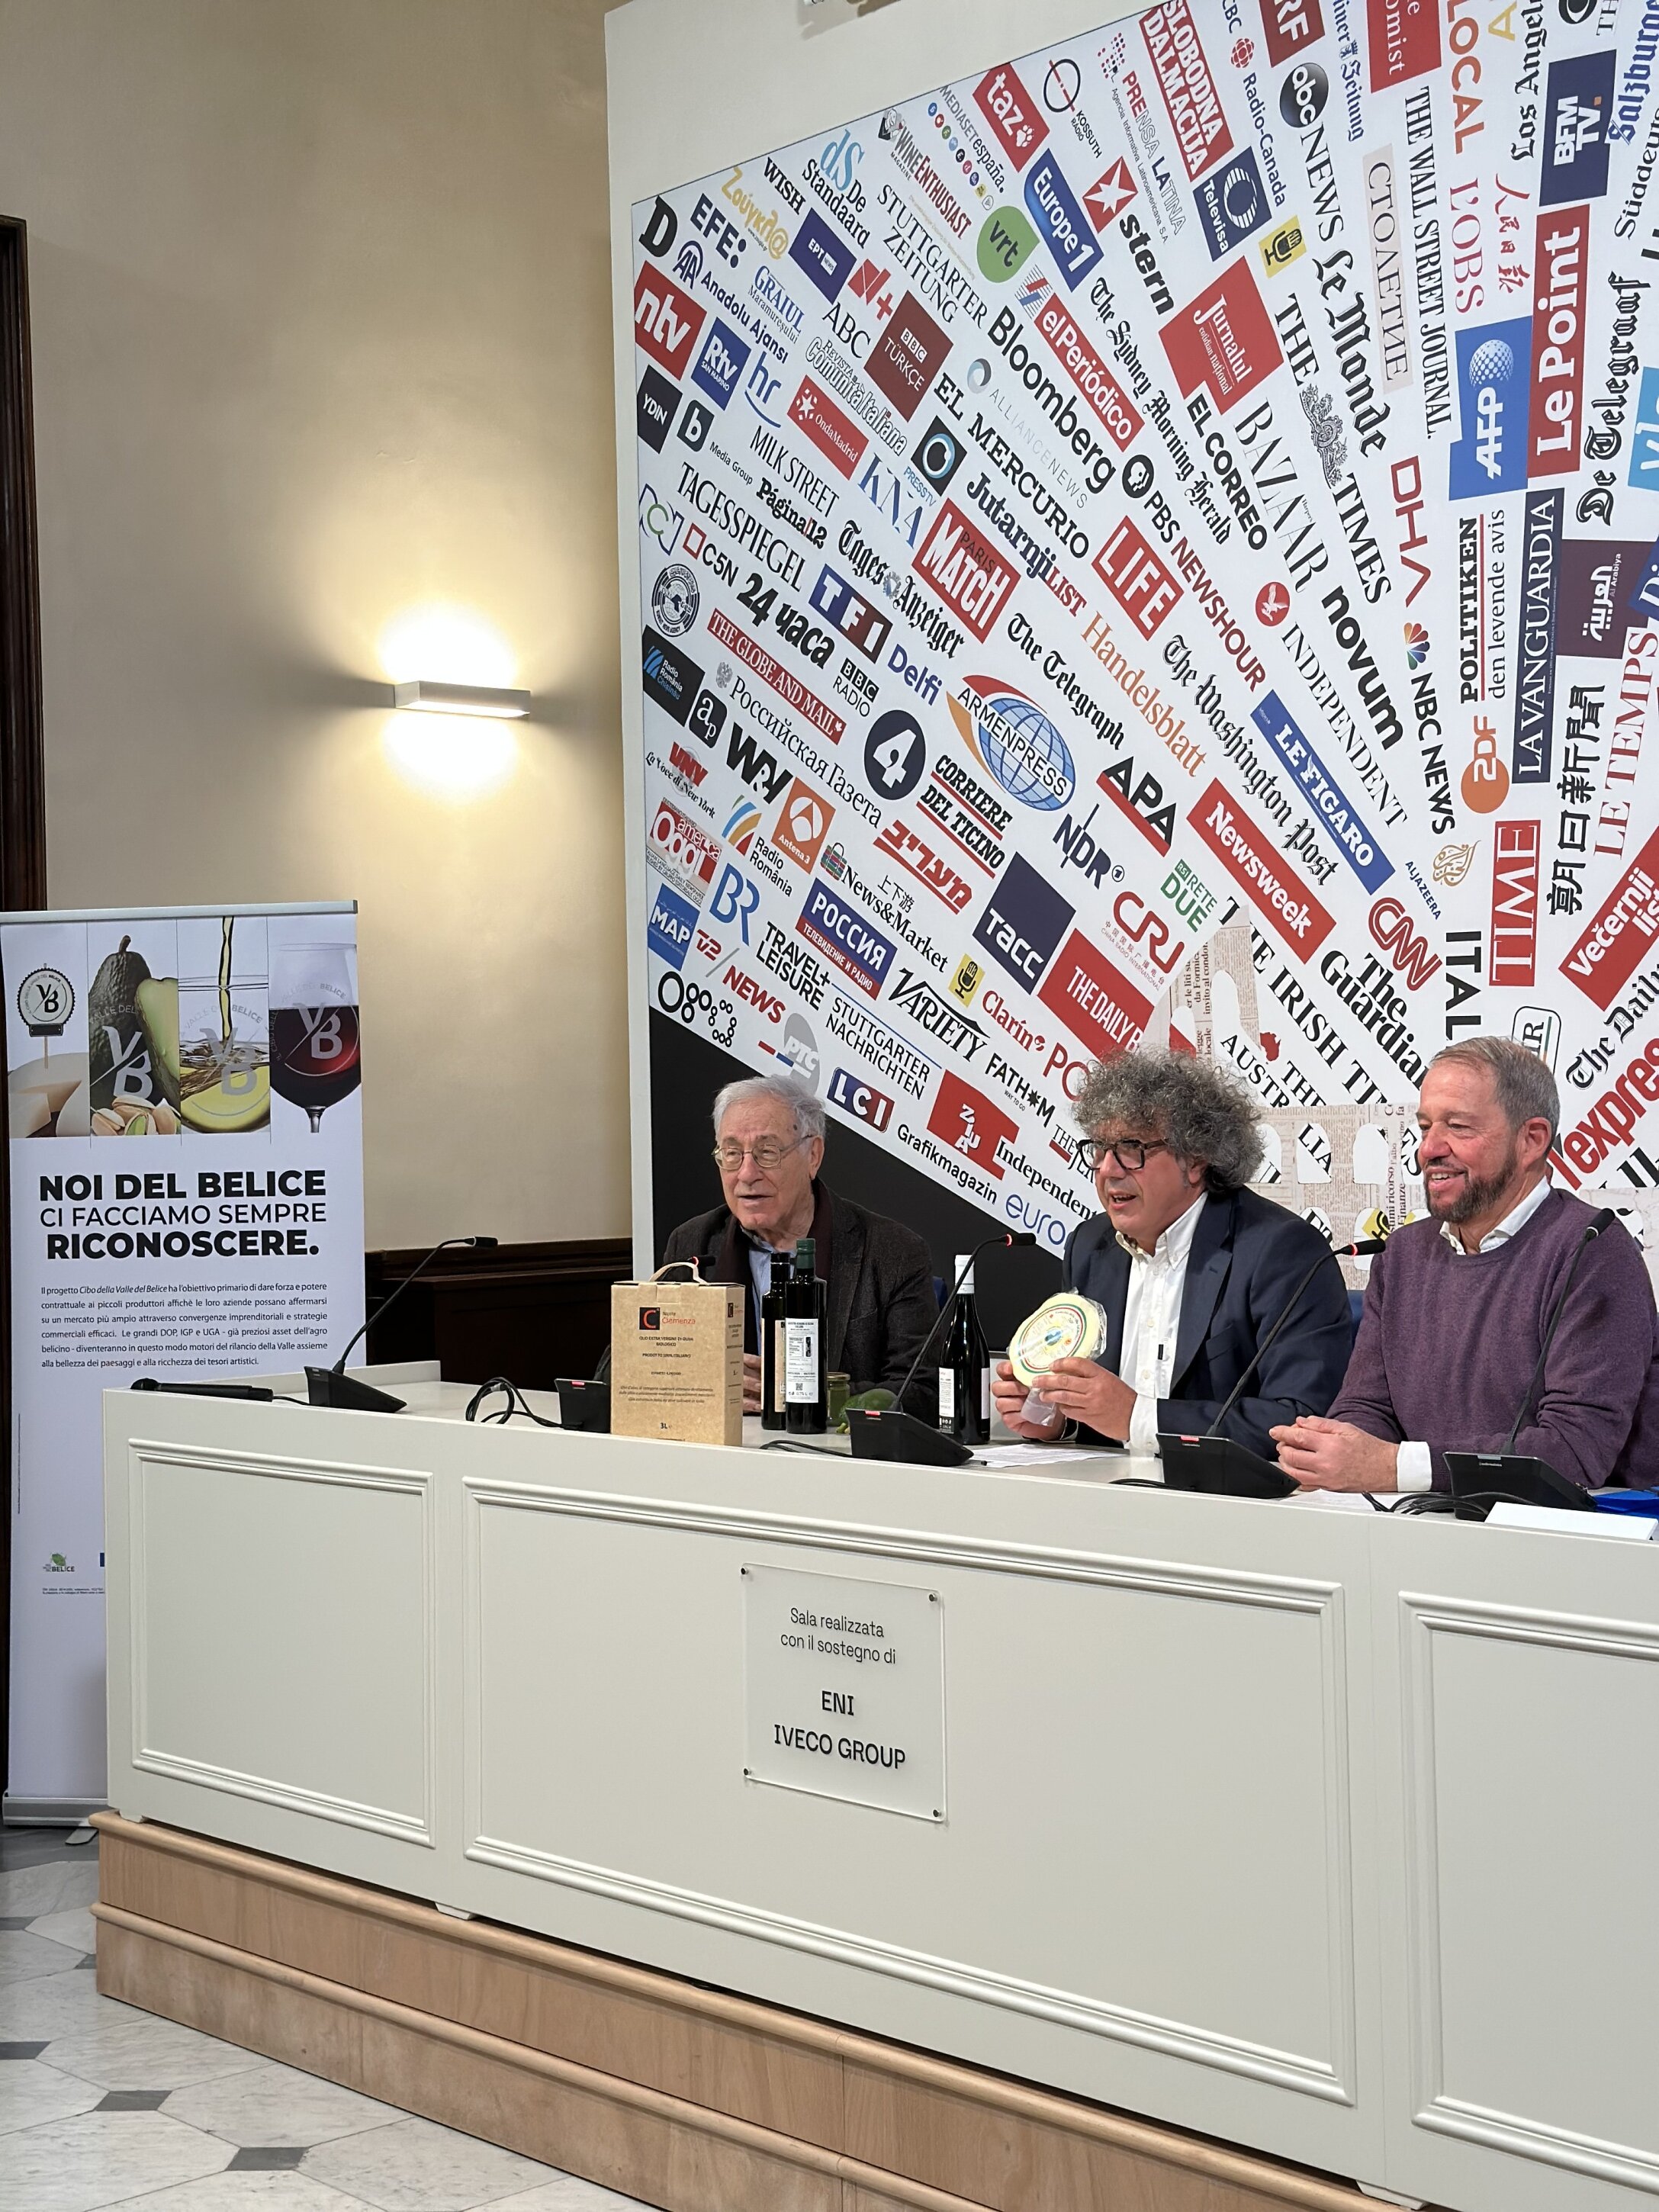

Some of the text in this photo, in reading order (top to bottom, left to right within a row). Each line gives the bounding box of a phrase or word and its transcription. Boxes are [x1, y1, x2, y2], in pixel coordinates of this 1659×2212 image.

[987, 72, 1024, 137] taz
[1076, 111, 1101, 159] KOSSUTH
[1145, 17, 1210, 175] DALMACIJA
[1243, 72, 1287, 207] Radio-Canada
[1405, 85, 1432, 145] THE
[764, 157, 807, 215] WISH
[847, 178, 866, 212] De
[893, 126, 924, 175] WINE
[915, 155, 972, 240] ENTHUSIAST
[1123, 71, 1187, 235] PRENSA LATINA
[1301, 122, 1344, 241] NEWS
[1410, 143, 1437, 218] WALL
[802, 159, 871, 249] Standaard
[990, 220, 1019, 267] vrt
[1202, 180, 1229, 253] Televisa
[702, 272, 751, 326] Anadolu
[754, 266, 805, 333] GRAIUL
[877, 185, 988, 329] STUTTGARTER
[883, 226, 958, 323] ZEITUNG
[1119, 214, 1175, 315] stern
[1414, 219, 1445, 318] STREET
[823, 301, 871, 358] ABC
[885, 338, 924, 392] TÜRKÇE
[1194, 294, 1252, 383] Jurnalul
[1312, 249, 1391, 458] Le Monde
[988, 305, 1117, 494] Bloomberg
[1091, 277, 1231, 545] The Sydney Morning Herald
[1576, 271, 1651, 526] De Telegraaf
[750, 426, 839, 518] MILK STREET
[934, 373, 1089, 558] EL MERCURIO
[1187, 393, 1267, 551] EL CORREO
[1275, 292, 1392, 603] THE TIMES
[677, 461, 807, 592] TAGESSPIEGEL
[1233, 397, 1329, 593] BAZAAR
[736, 572, 779, 627] 24
[838, 520, 966, 659] Tages Anzeiger
[1099, 526, 1176, 631] LIFE
[1143, 490, 1266, 692] PBS NEWSHOUR
[1459, 517, 1478, 703] POLITIKEN
[711, 614, 834, 735] THE GLOBE AND MAIL
[887, 644, 943, 706] Delfi
[1008, 612, 1125, 750] The Telegraph
[1080, 610, 1209, 777] Handelsblatt
[1321, 585, 1404, 751] novum
[957, 688, 1068, 797] ARMENPRESS
[1162, 635, 1339, 886] The Washington Post
[1281, 622, 1408, 828] INDEPENDENT
[1411, 672, 1455, 834] NBC NEWS
[1594, 632, 1658, 860] LE TEMPS
[920, 785, 1006, 869] DEL TICINO
[935, 754, 1013, 832] CORRIERE
[1275, 724, 1374, 866] LE FIGARO
[877, 875, 915, 913] 上下游
[1206, 801, 1312, 938] Newsweek
[1492, 825, 1537, 982] TIME
[811, 892, 886, 971] РОССИЯ
[841, 864, 948, 973] News&Market
[1368, 897, 1443, 991] CNN
[231, 1004, 263, 1024] BELICE
[825, 1013, 924, 1100] NACHRICHTEN
[832, 997, 931, 1082] STUTTGARTER
[889, 968, 990, 1063] VARIETY
[1267, 965, 1349, 1069] IRISH
[40, 1169, 326, 1201] NOI DEL BELICE
[897, 1124, 998, 1205] Grafikmagazin
[40, 1202, 326, 1227] CI FACCIAMO SEMPRE
[47, 1230, 319, 1259] RICONOSCERE.
[47, 1288, 78, 1296] progetto
[217, 1284, 248, 1293] primario
[98, 1301, 122, 1310] piccoli
[126, 1300, 164, 1309] produttori
[133, 1329, 157, 1339] grandi
[242, 1328, 269, 1336] preziosi
[294, 1313, 327, 1321] strategie
[662, 1317, 696, 1325] Clemenza
[101, 1359, 134, 1368] paesaggi
[137, 1345, 163, 1353] questo
[780, 1634, 896, 1664] con il sostegno di
[790, 1606, 884, 1638] Sala realizzata
[774, 1724, 906, 1770] IVECO GROUP
[821, 1690, 854, 1716] ENI
